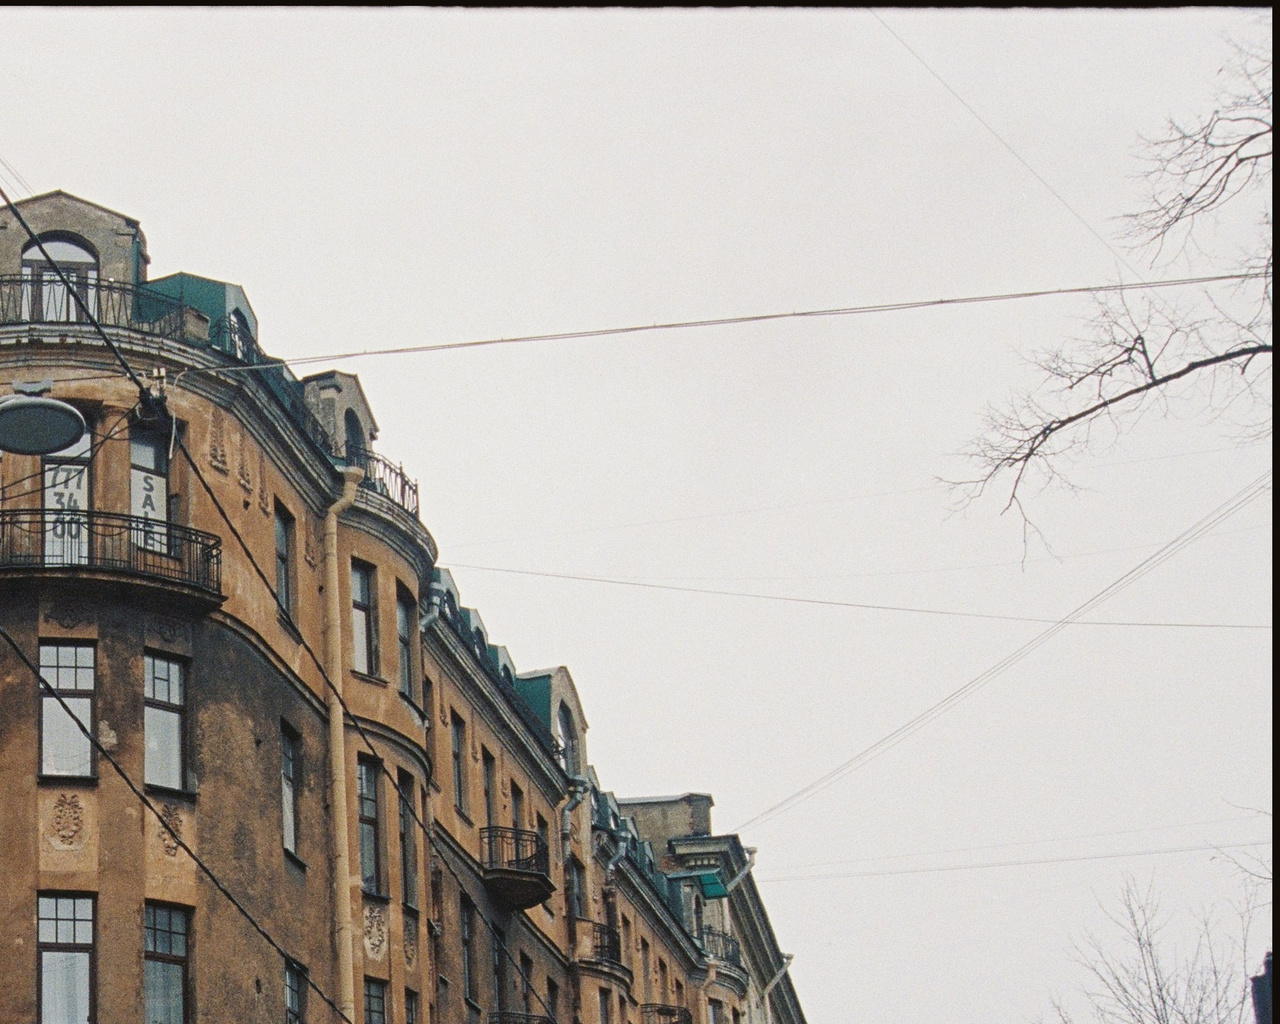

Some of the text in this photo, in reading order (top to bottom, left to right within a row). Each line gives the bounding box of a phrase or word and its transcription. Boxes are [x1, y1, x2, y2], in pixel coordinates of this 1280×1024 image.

[47, 467, 85, 490] 777
[53, 492, 80, 515] 34
[141, 475, 156, 548] SALE
